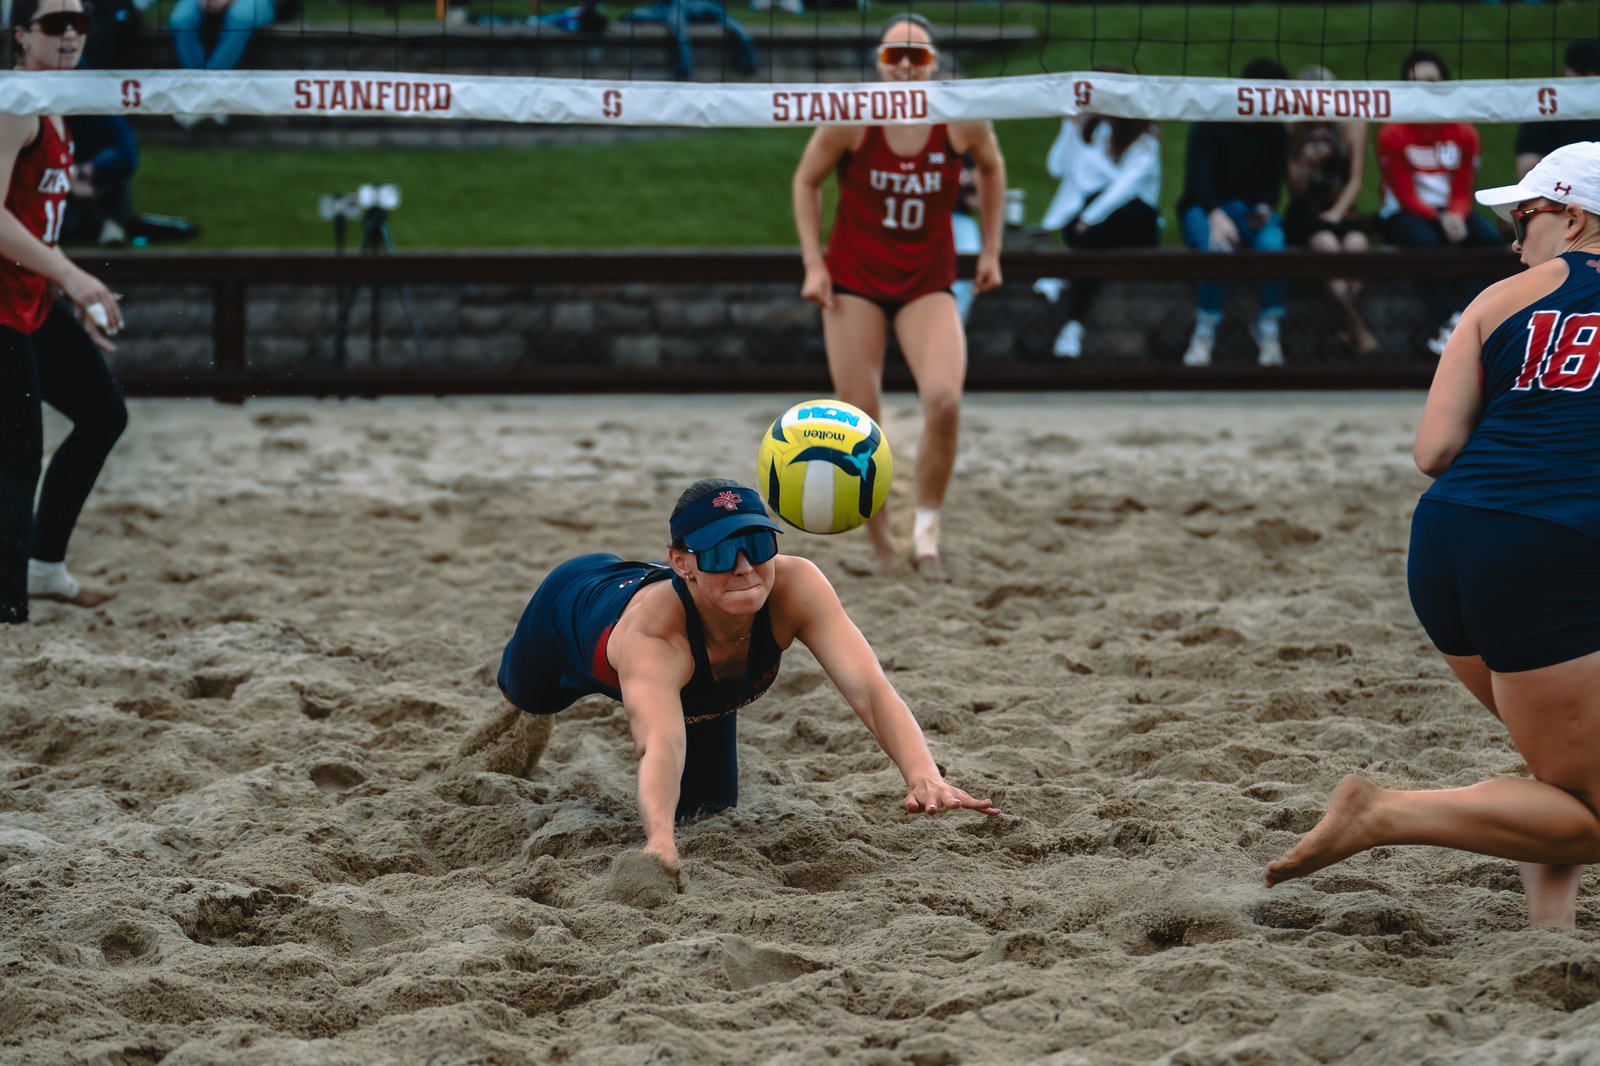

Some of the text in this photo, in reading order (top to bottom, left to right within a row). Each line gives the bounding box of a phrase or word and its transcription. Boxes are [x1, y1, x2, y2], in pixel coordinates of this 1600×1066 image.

[294, 79, 452, 112] STANFORD
[772, 90, 928, 122] STANFORD
[1237, 86, 1392, 118] STANFORD
[869, 168, 942, 195] UTAH
[881, 197, 926, 230] 10
[1510, 310, 1600, 392] 18
[797, 406, 861, 428] NCAA
[803, 429, 846, 442] molten
